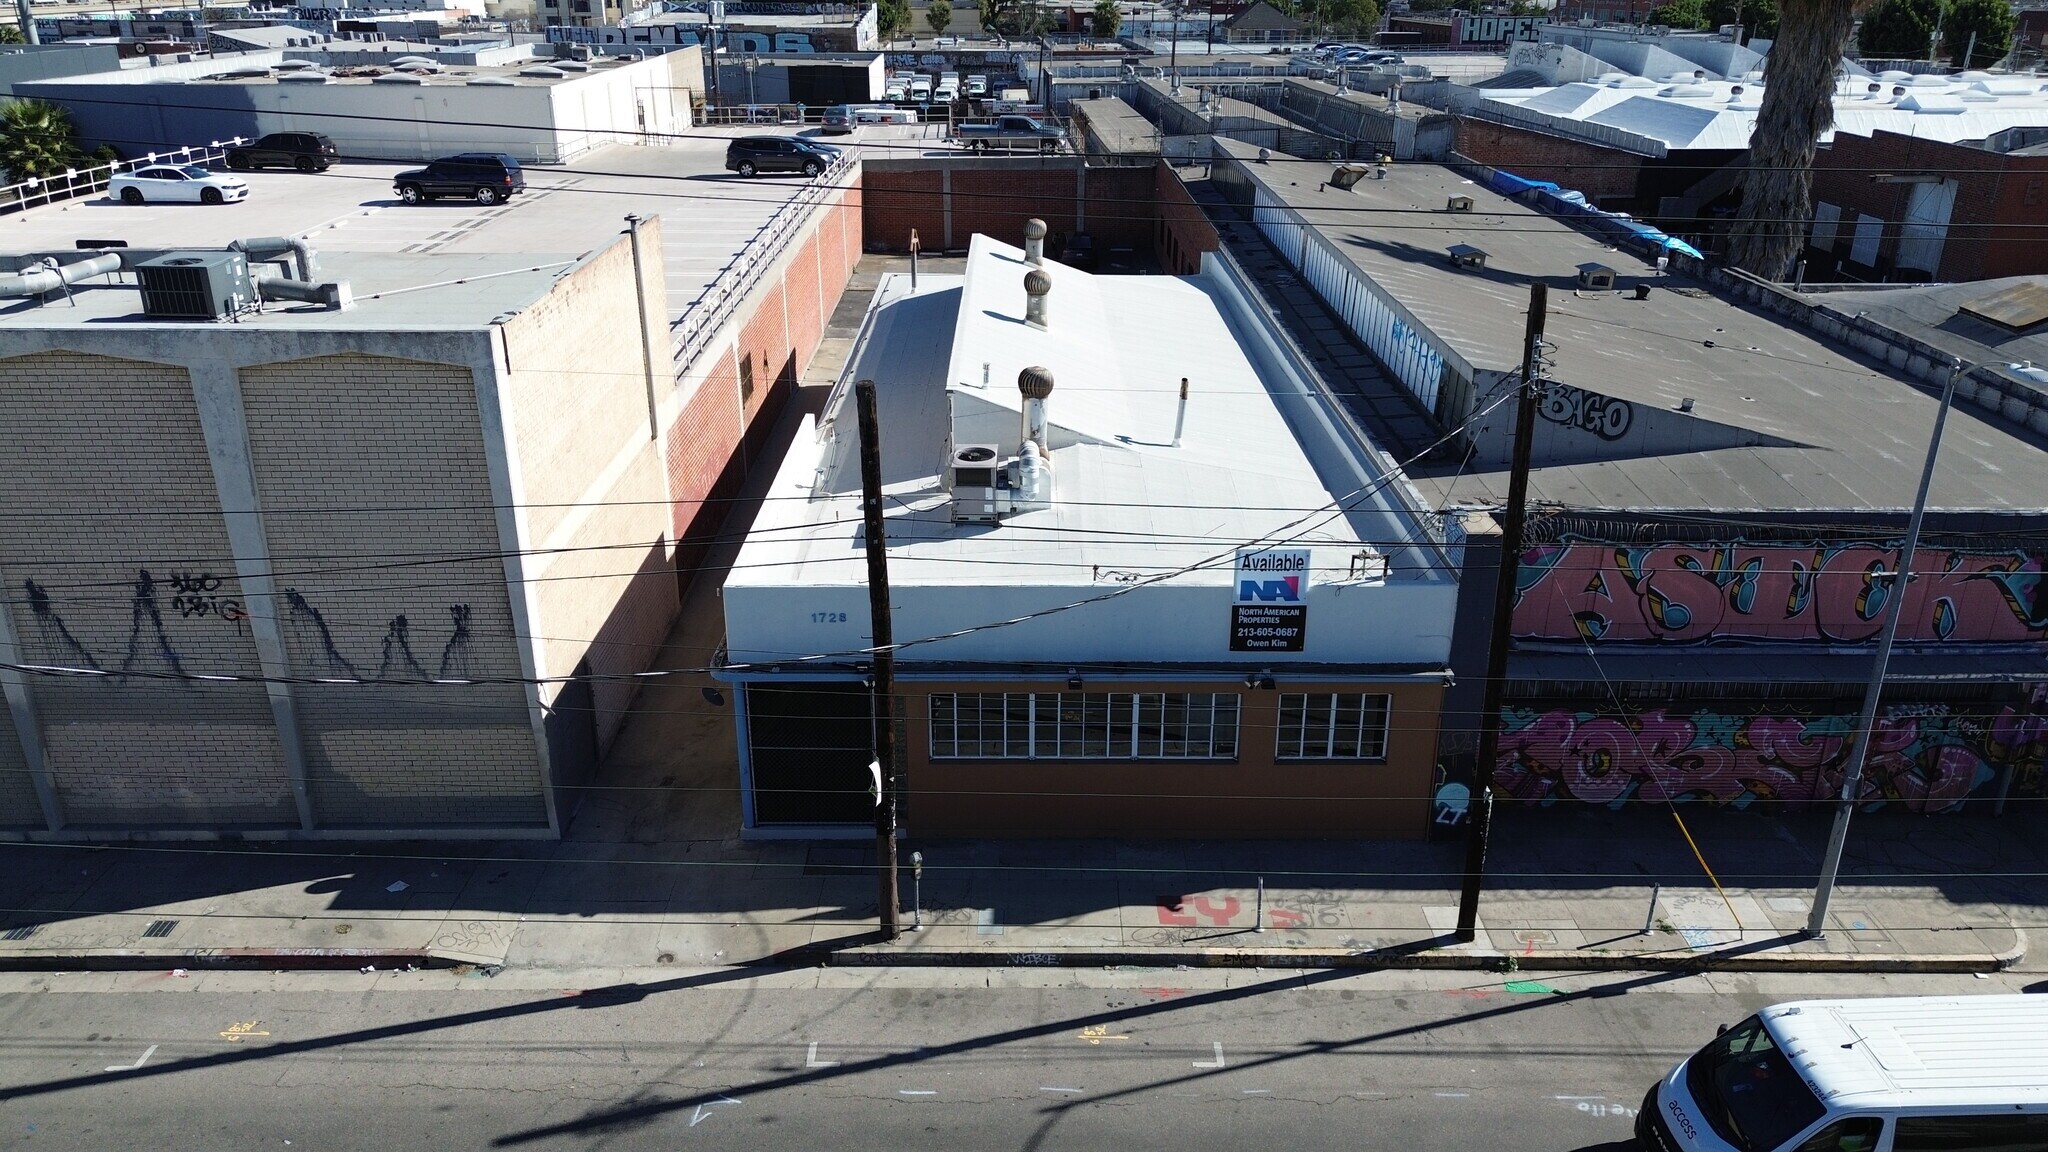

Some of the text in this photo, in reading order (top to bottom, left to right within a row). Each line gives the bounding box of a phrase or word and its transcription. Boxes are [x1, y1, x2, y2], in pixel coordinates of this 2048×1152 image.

[1462, 17, 1549, 41] HOPES
[1241, 553, 1304, 571] Available
[811, 612, 847, 623] 1728
[1238, 615, 1280, 624] PROPERTIES
[1237, 627, 1298, 637] 213-605-0687
[1246, 639, 1288, 647] Owen Kim
[1668, 1099, 1697, 1140] access
